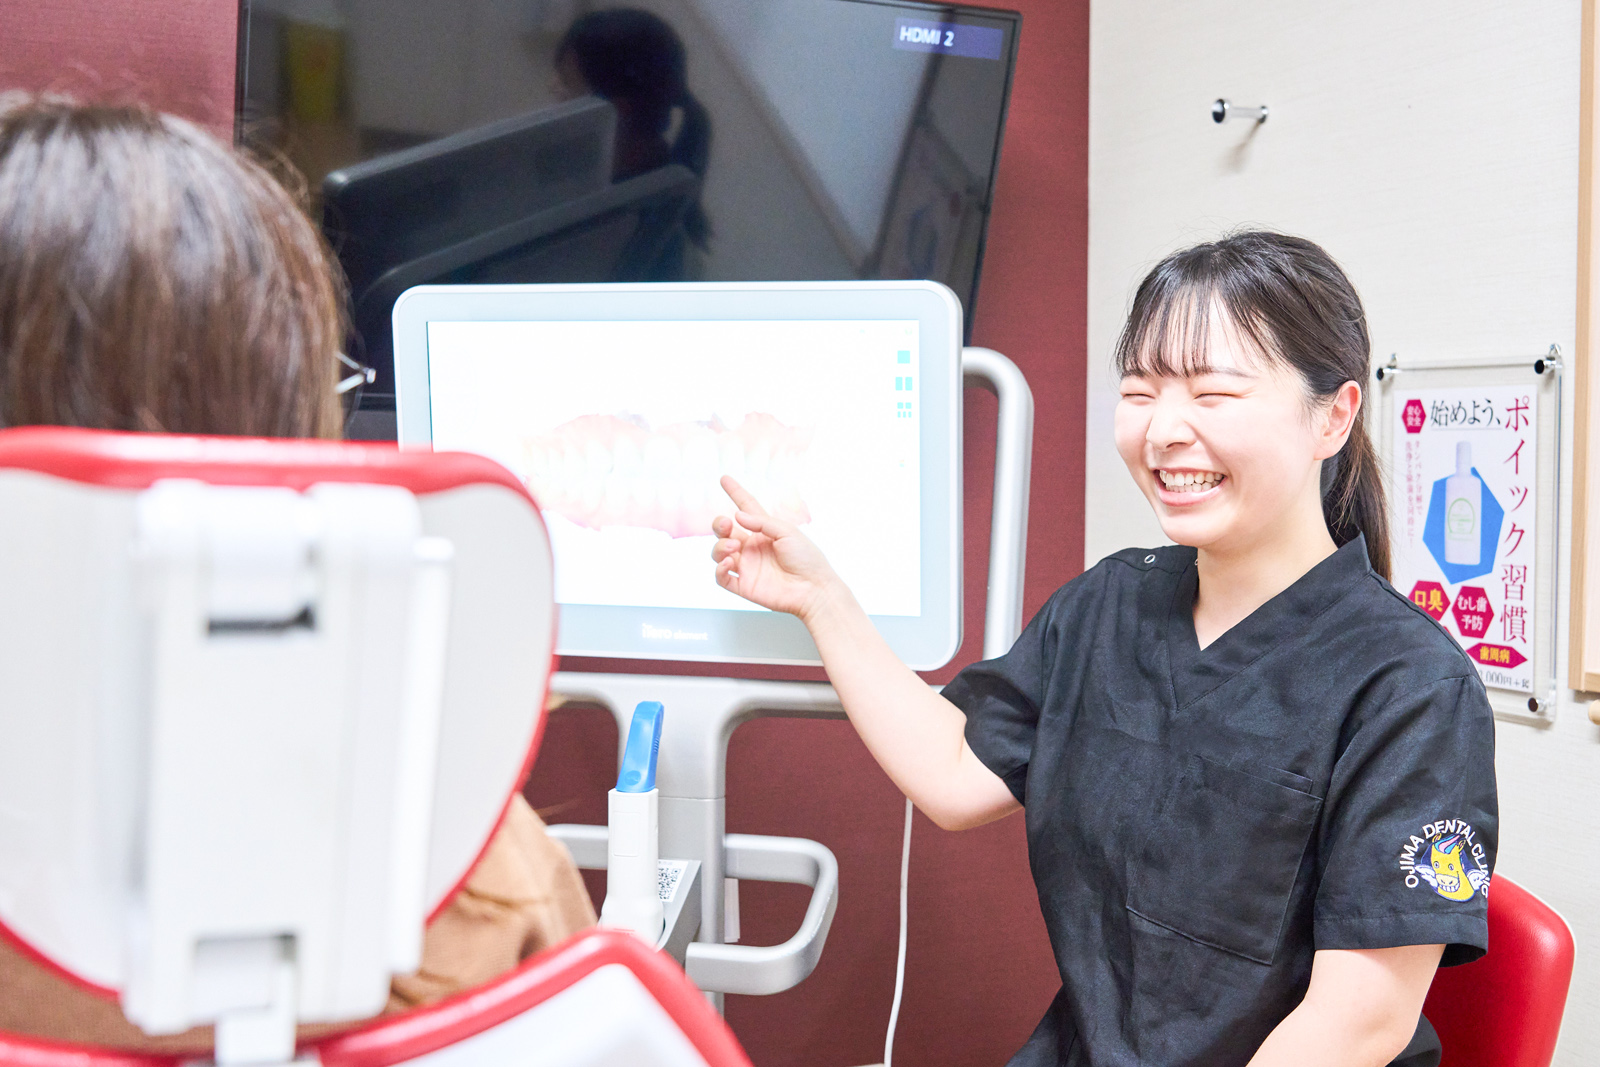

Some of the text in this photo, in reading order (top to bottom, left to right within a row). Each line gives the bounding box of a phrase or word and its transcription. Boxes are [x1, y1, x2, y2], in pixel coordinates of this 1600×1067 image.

[900, 25, 955, 47] HDMI 2
[1430, 398, 1501, 427] 始めよう、
[1500, 394, 1530, 644] ポイック習慣
[1414, 588, 1443, 613] 口臭
[1457, 595, 1488, 613] むし歯
[1461, 614, 1483, 631] 予防
[1480, 646, 1510, 664] 歯周病
[1399, 835, 1425, 889] OJIMA
[1422, 819, 1476, 847] DENTAL
